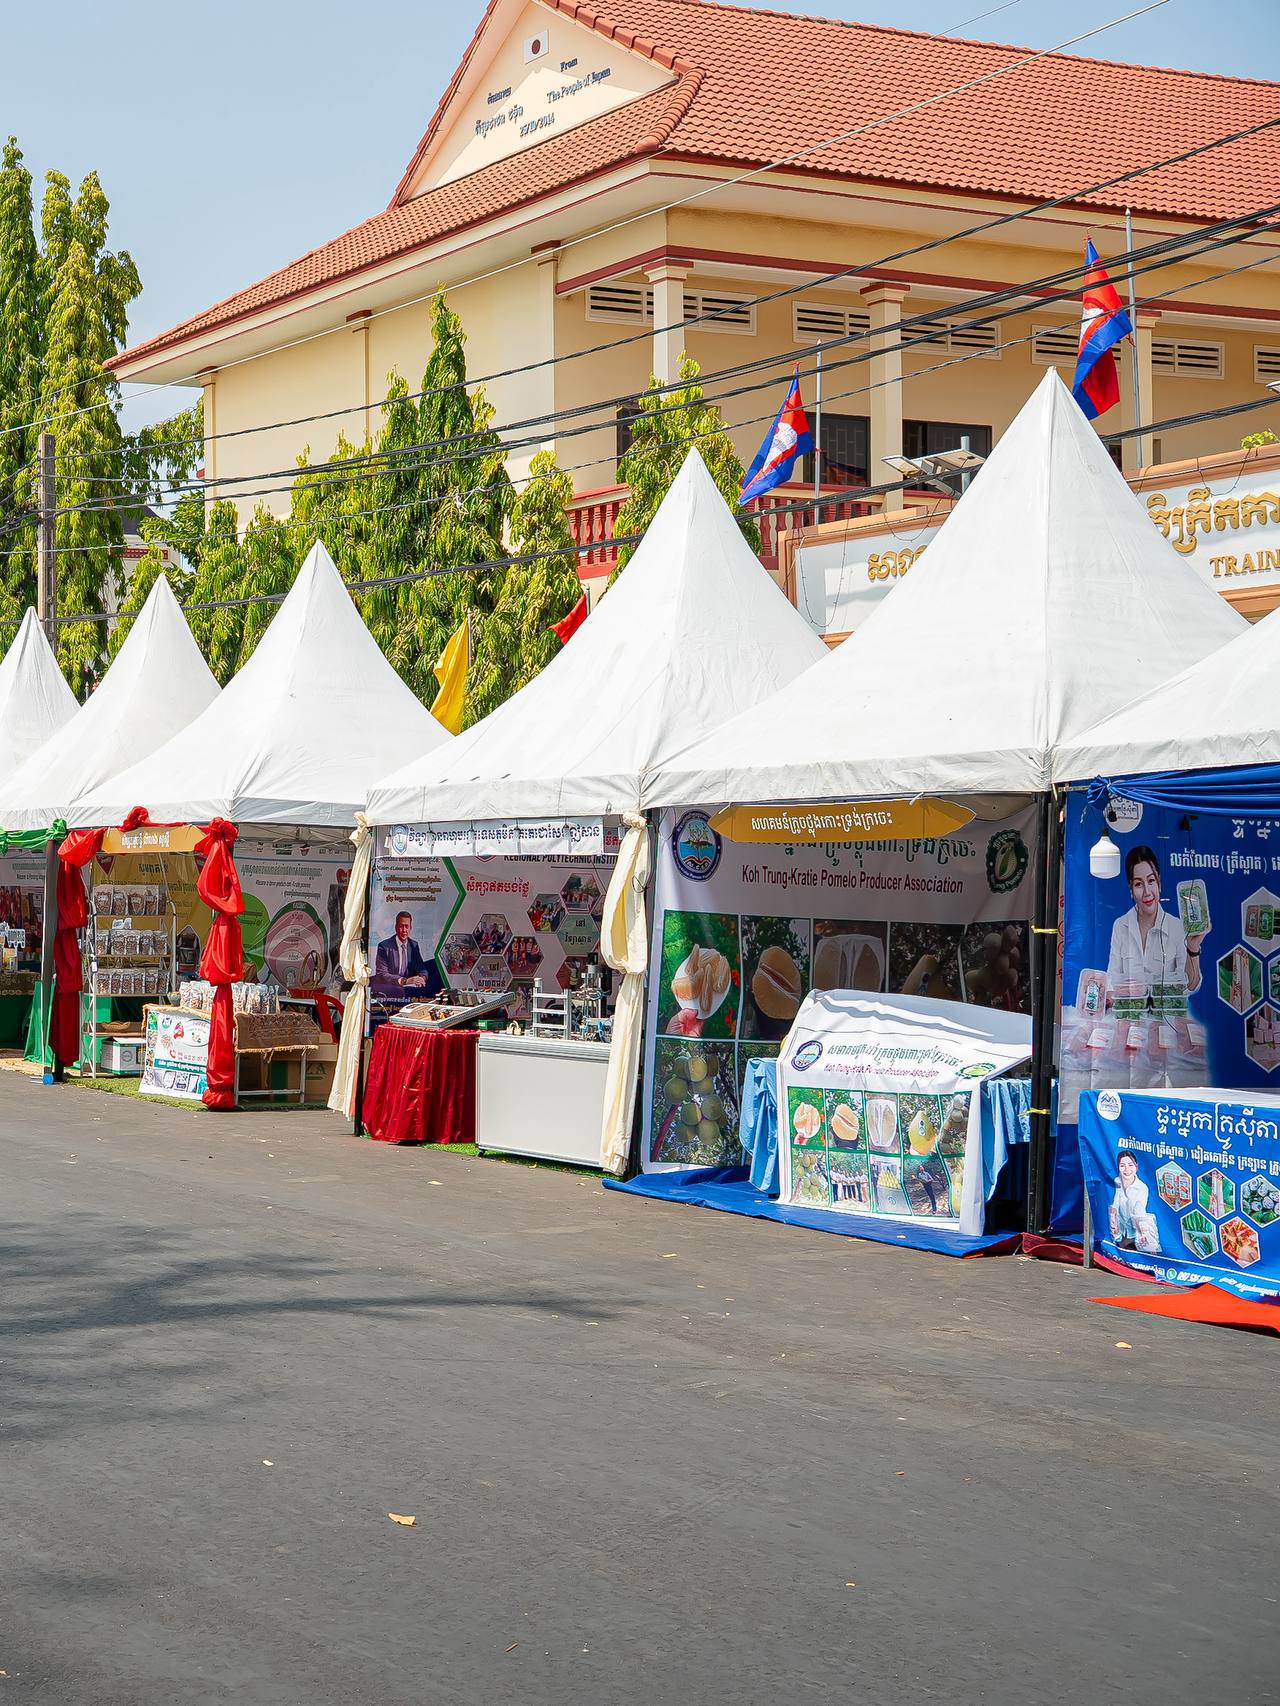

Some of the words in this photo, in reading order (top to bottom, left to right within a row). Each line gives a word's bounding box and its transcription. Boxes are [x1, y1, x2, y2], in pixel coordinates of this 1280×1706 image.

[560, 58, 577, 72] From
[547, 90, 560, 103] The
[560, 80, 582, 97] People
[591, 68, 611, 84] Japan
[742, 865, 760, 883] Koh
[762, 866, 818, 889] Trung-Kratie
[821, 872, 856, 888] Pomelo
[860, 872, 902, 890] Producer
[904, 874, 964, 894] Association
